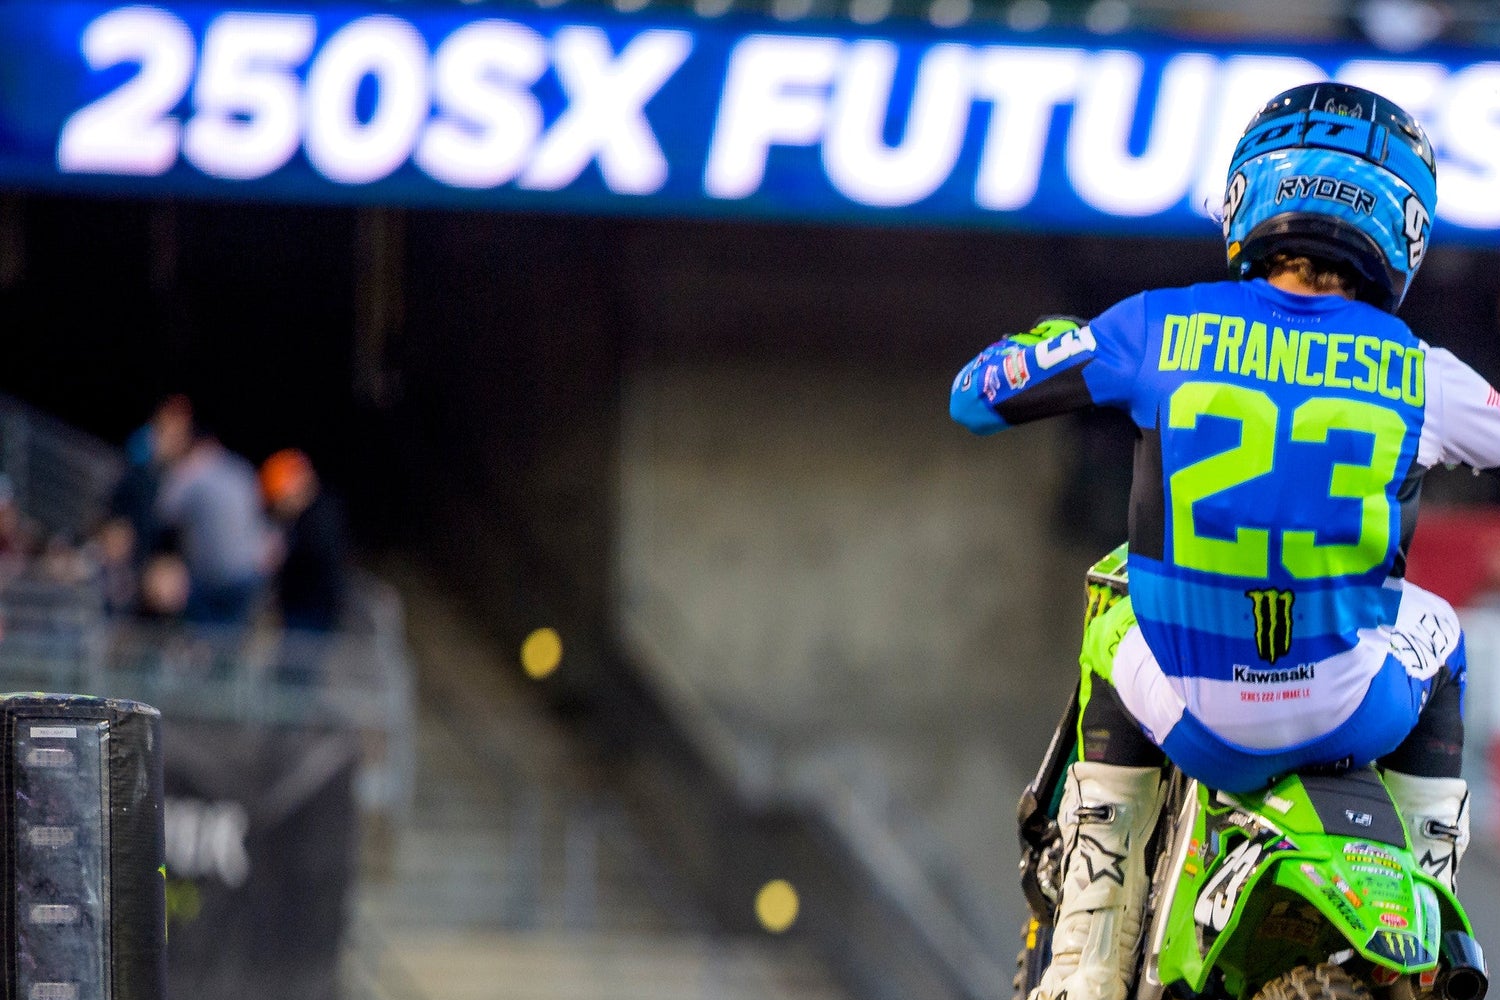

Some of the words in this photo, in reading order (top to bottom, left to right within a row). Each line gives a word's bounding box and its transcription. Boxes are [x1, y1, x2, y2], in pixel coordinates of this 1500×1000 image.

[57, 6, 693, 195] 250SX
[1275, 174, 1377, 217] RYDER
[1158, 312, 1425, 408] DIFRANCESCO
[1168, 381, 1408, 580] 23
[1233, 664, 1315, 684] Kawasaki
[1194, 839, 1263, 932] 23
